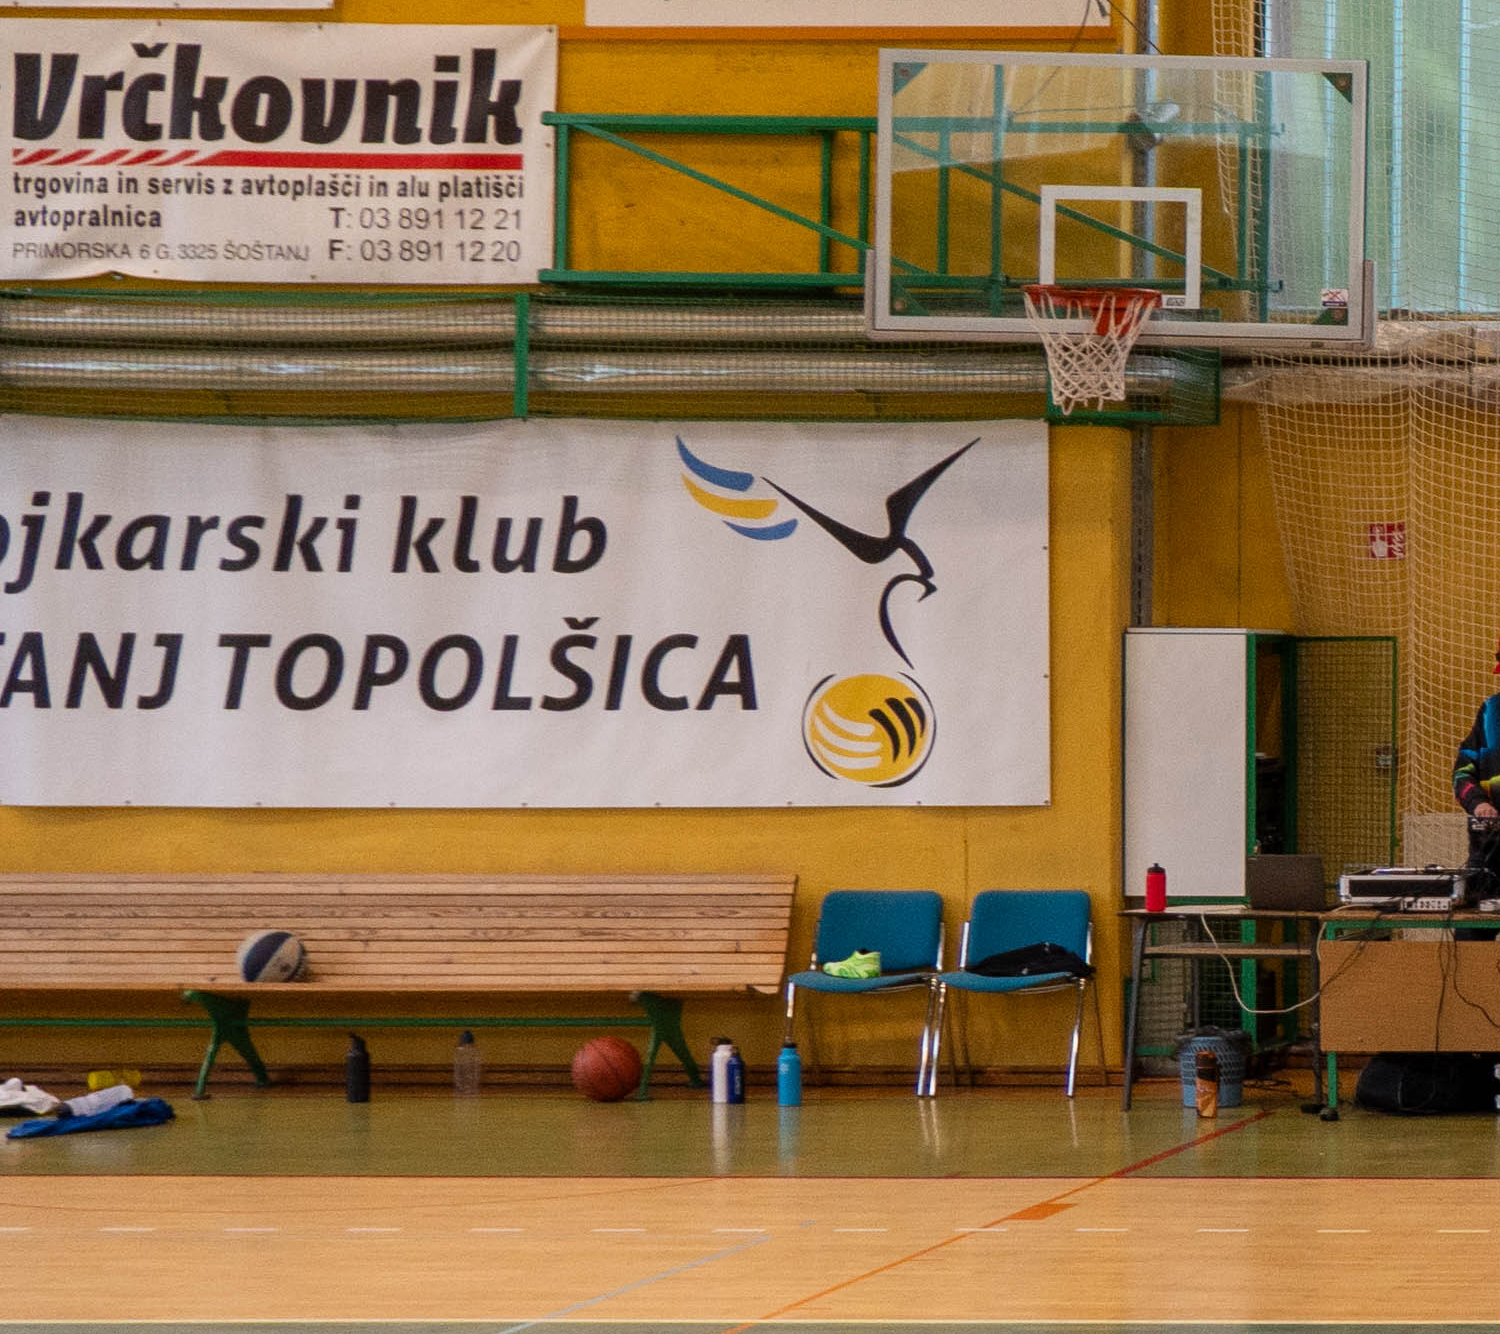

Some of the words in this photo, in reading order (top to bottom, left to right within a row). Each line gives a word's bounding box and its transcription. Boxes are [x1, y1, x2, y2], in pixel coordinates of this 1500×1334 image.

[12, 42, 525, 146] Vrčkovnik
[12, 171, 109, 199] trgovina
[117, 171, 138, 194] in
[147, 172, 216, 196] servis
[222, 178, 234, 195] z
[240, 171, 361, 201] avtoplašči
[368, 174, 389, 197] in
[396, 174, 430, 198] alu
[438, 174, 525, 202] platišči
[13, 205, 163, 232] avtopralnica
[329, 208, 352, 230] T:
[359, 208, 391, 230] 03
[399, 208, 445, 230] 891
[454, 208, 487, 230] 12
[498, 208, 523, 230] 21
[11, 241, 132, 261] PRIMORSKA
[138, 242, 151, 260] 6
[176, 242, 219, 261] 3325
[223, 239, 311, 262] ŠOŠTANJ
[328, 240, 352, 262] F:
[359, 240, 390, 262] 03
[399, 240, 445, 262] 891
[0, 491, 363, 595] jkarski
[391, 493, 609, 574] klub
[0, 630, 185, 710] ANJ
[218, 616, 760, 712] TOPOLŠICA
